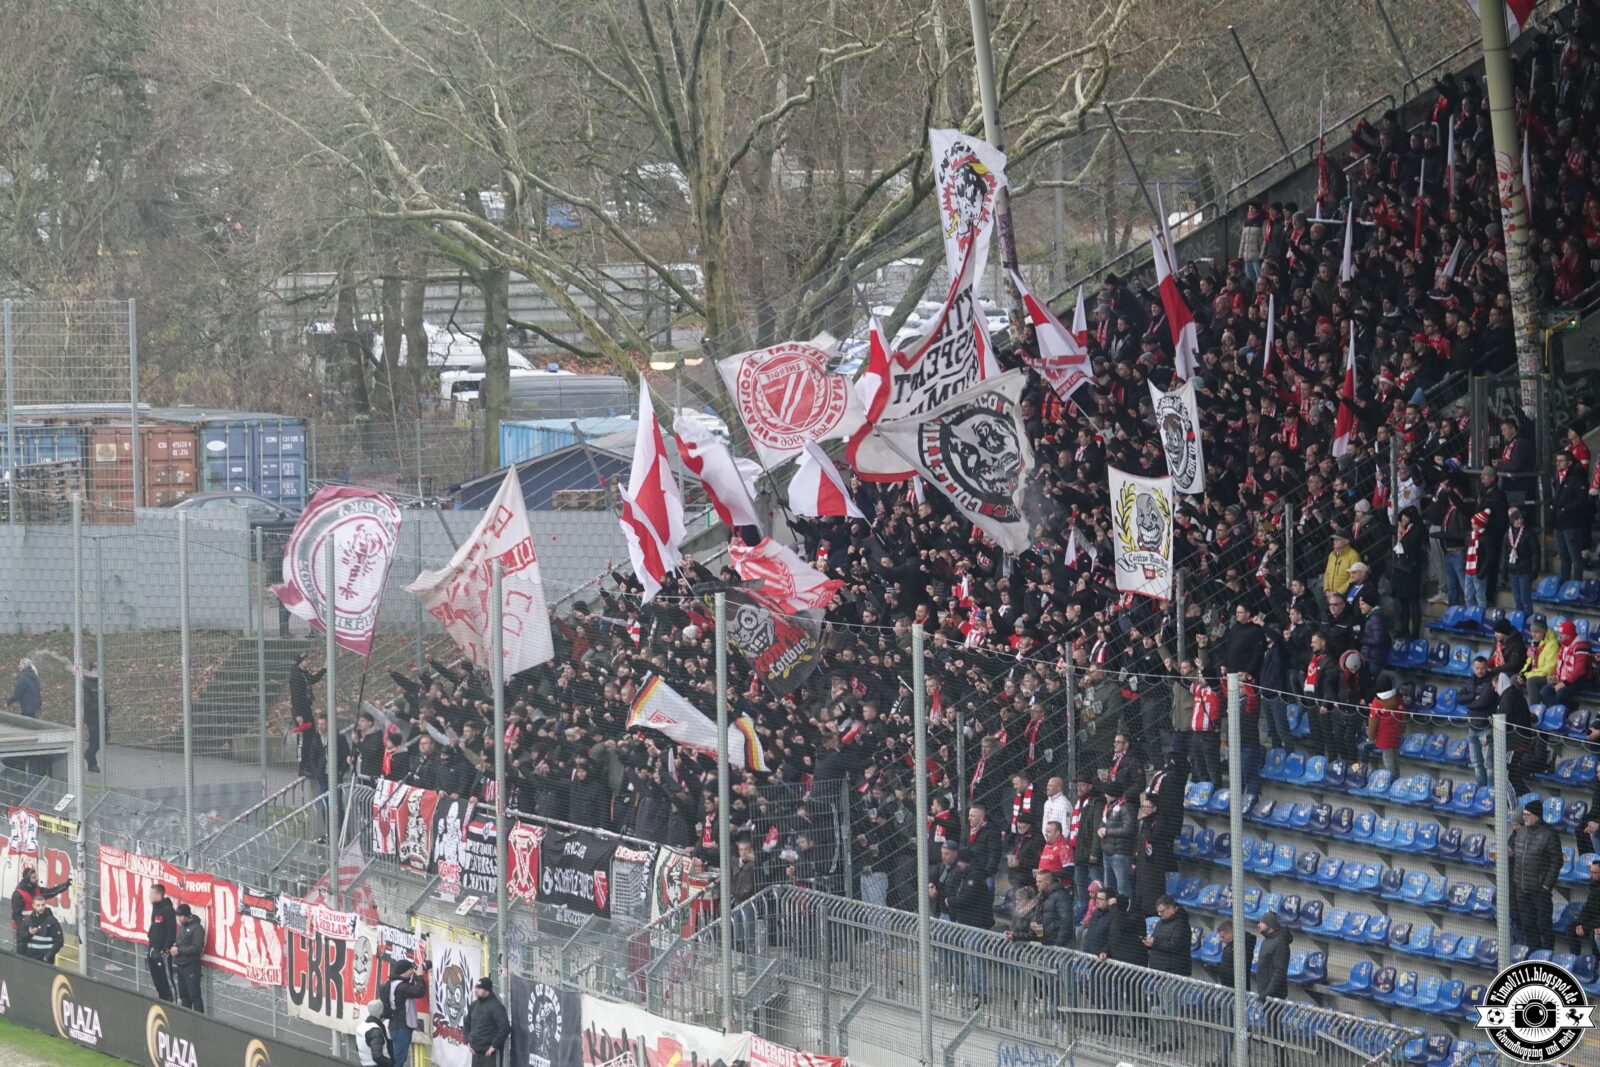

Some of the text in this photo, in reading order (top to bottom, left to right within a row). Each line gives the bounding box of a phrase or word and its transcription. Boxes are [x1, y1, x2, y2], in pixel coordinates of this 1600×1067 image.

[769, 637, 811, 677] Cottbus
[185, 881, 212, 893] FRONT
[288, 929, 346, 1019] CBR
[62, 999, 103, 1039] PLAZA
[158, 1031, 198, 1067] PLAZA
